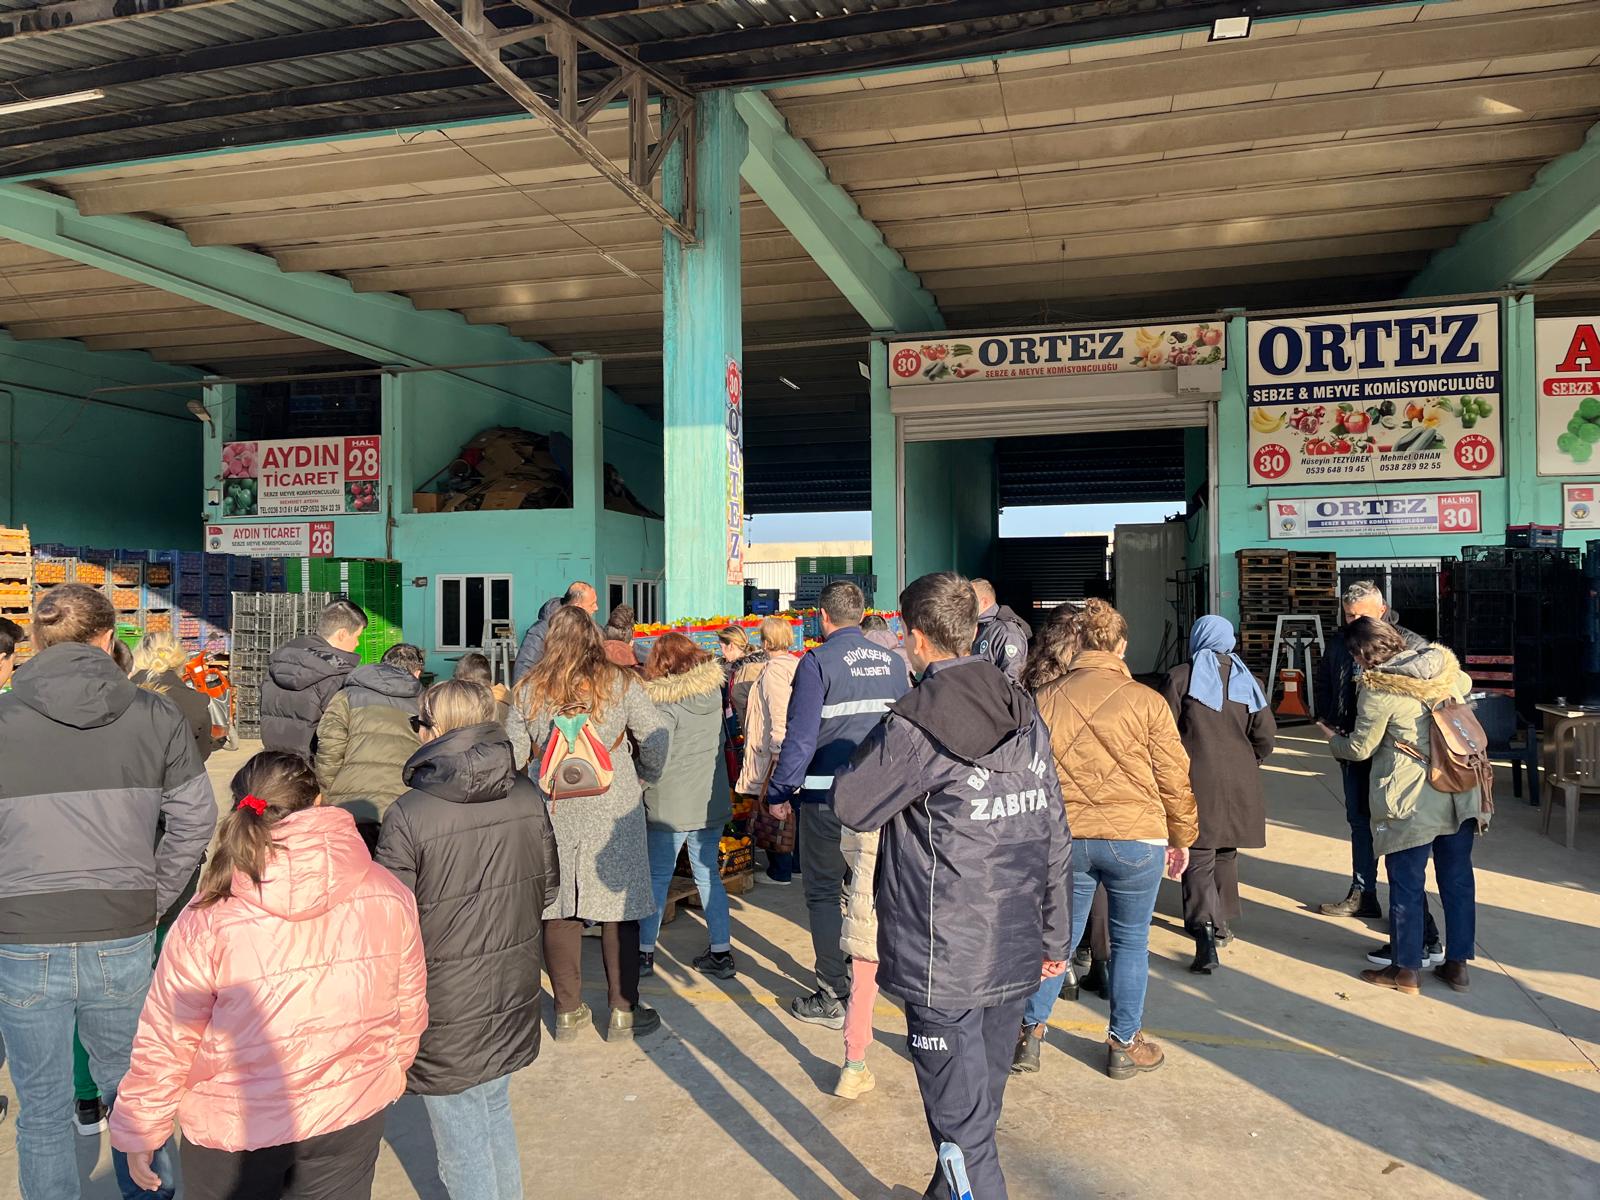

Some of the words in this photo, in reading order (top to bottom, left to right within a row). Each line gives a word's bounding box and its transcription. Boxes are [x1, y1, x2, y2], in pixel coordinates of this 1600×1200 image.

[979, 332, 1124, 366] ORTEZ
[1258, 313, 1480, 376] ORTEZ
[898, 357, 917, 372] 30
[985, 370, 1008, 378] SEBZE
[1011, 369, 1016, 377] &
[1018, 367, 1045, 376] MEYVE
[1046, 362, 1118, 375] KOMİSYONCULUĞU
[1253, 387, 1294, 402] SEBZE
[1299, 386, 1309, 400] &
[1313, 383, 1360, 399] MEYVE
[1364, 374, 1495, 396] KOMİSYONCULUĞU
[1551, 381, 1594, 395] SEBZE
[1461, 435, 1475, 445] HAL
[1477, 435, 1488, 444] NO
[262, 444, 340, 469] AYDIN
[1260, 445, 1273, 455] HAL
[1274, 445, 1285, 454] NO
[1380, 454, 1411, 462] Mehmet
[1413, 452, 1441, 460] ORHAN
[1461, 445, 1488, 464] 30
[348, 448, 379, 477] 28
[1260, 455, 1285, 472] 30
[1306, 467, 1325, 475] 0539
[1345, 465, 1354, 473] 19
[1355, 465, 1366, 473] 45
[1401, 463, 1417, 471] 289
[1418, 462, 1429, 470] 92
[1431, 461, 1441, 470] 55
[263, 471, 339, 487] TİCARET
[728, 408, 740, 560] ORTEZ
[1316, 498, 1427, 517] ORTEZ
[1441, 496, 1457, 505] HAL
[1443, 508, 1472, 528] 30
[233, 527, 260, 539] AYDIN
[263, 524, 301, 539] TİCARET
[312, 531, 332, 554] 28
[843, 647, 892, 666] BÜYÜKŞEHİR
[970, 788, 1048, 820] ZABITA
[912, 1034, 948, 1051] ZABITA
